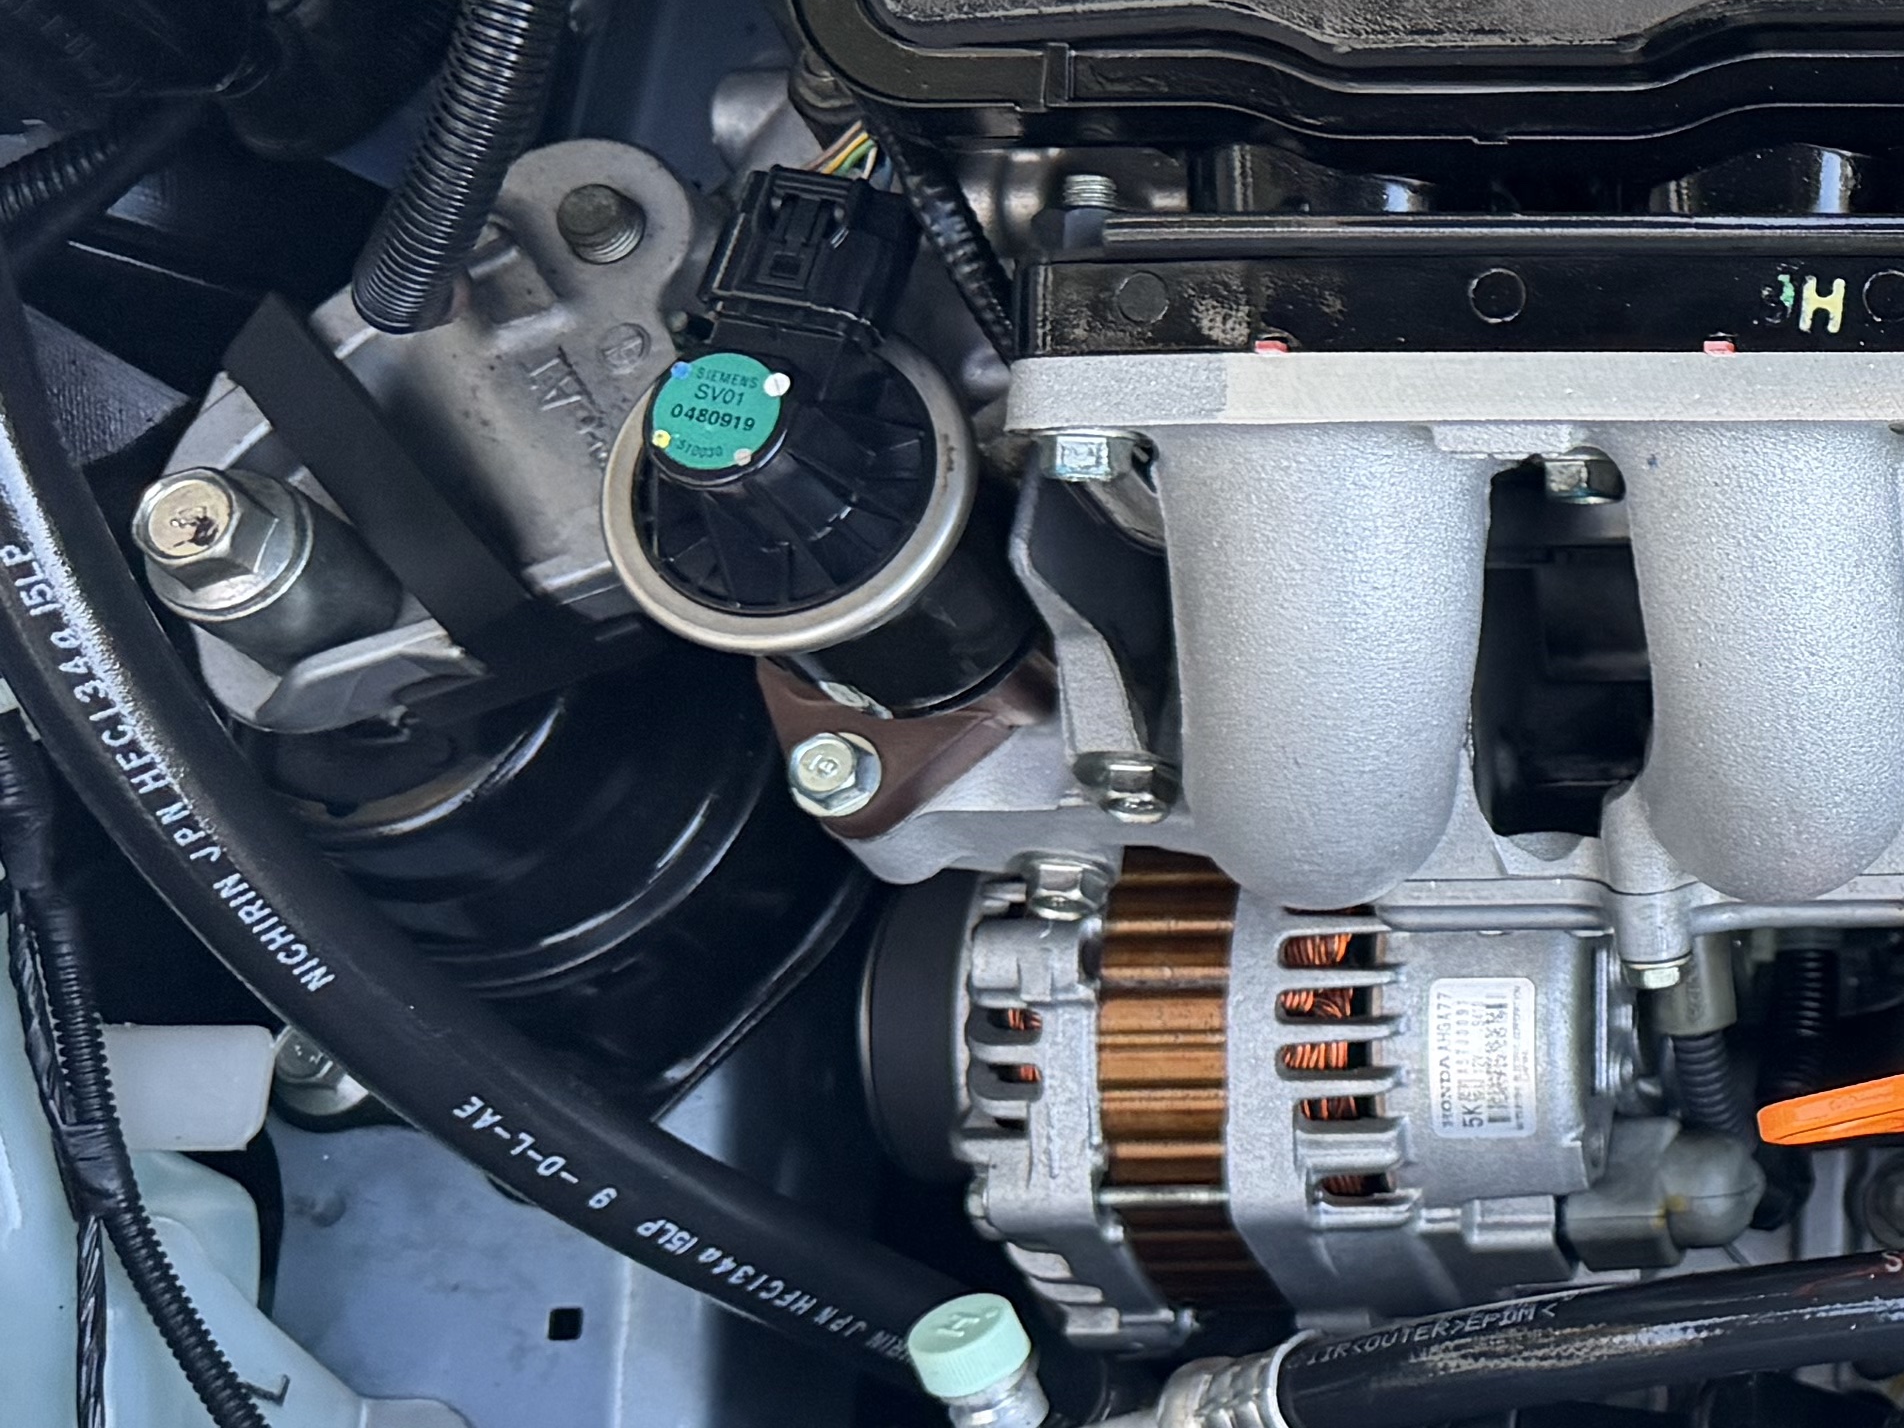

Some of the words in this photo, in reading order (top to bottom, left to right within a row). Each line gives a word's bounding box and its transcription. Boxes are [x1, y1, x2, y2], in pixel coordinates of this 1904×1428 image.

[694, 383, 745, 406] SV01
[696, 367, 759, 389] SIEMENS
[671, 403, 756, 432] 0480919
[156, 801, 222, 862] JPN
[213, 872, 335, 993] NICHIRIN
[1439, 1055, 1454, 1128] HONDA
[1461, 1104, 1484, 1128] 5K
[636, 1217, 699, 1256] 15LP
[699, 1247, 817, 1313] HFC134a
